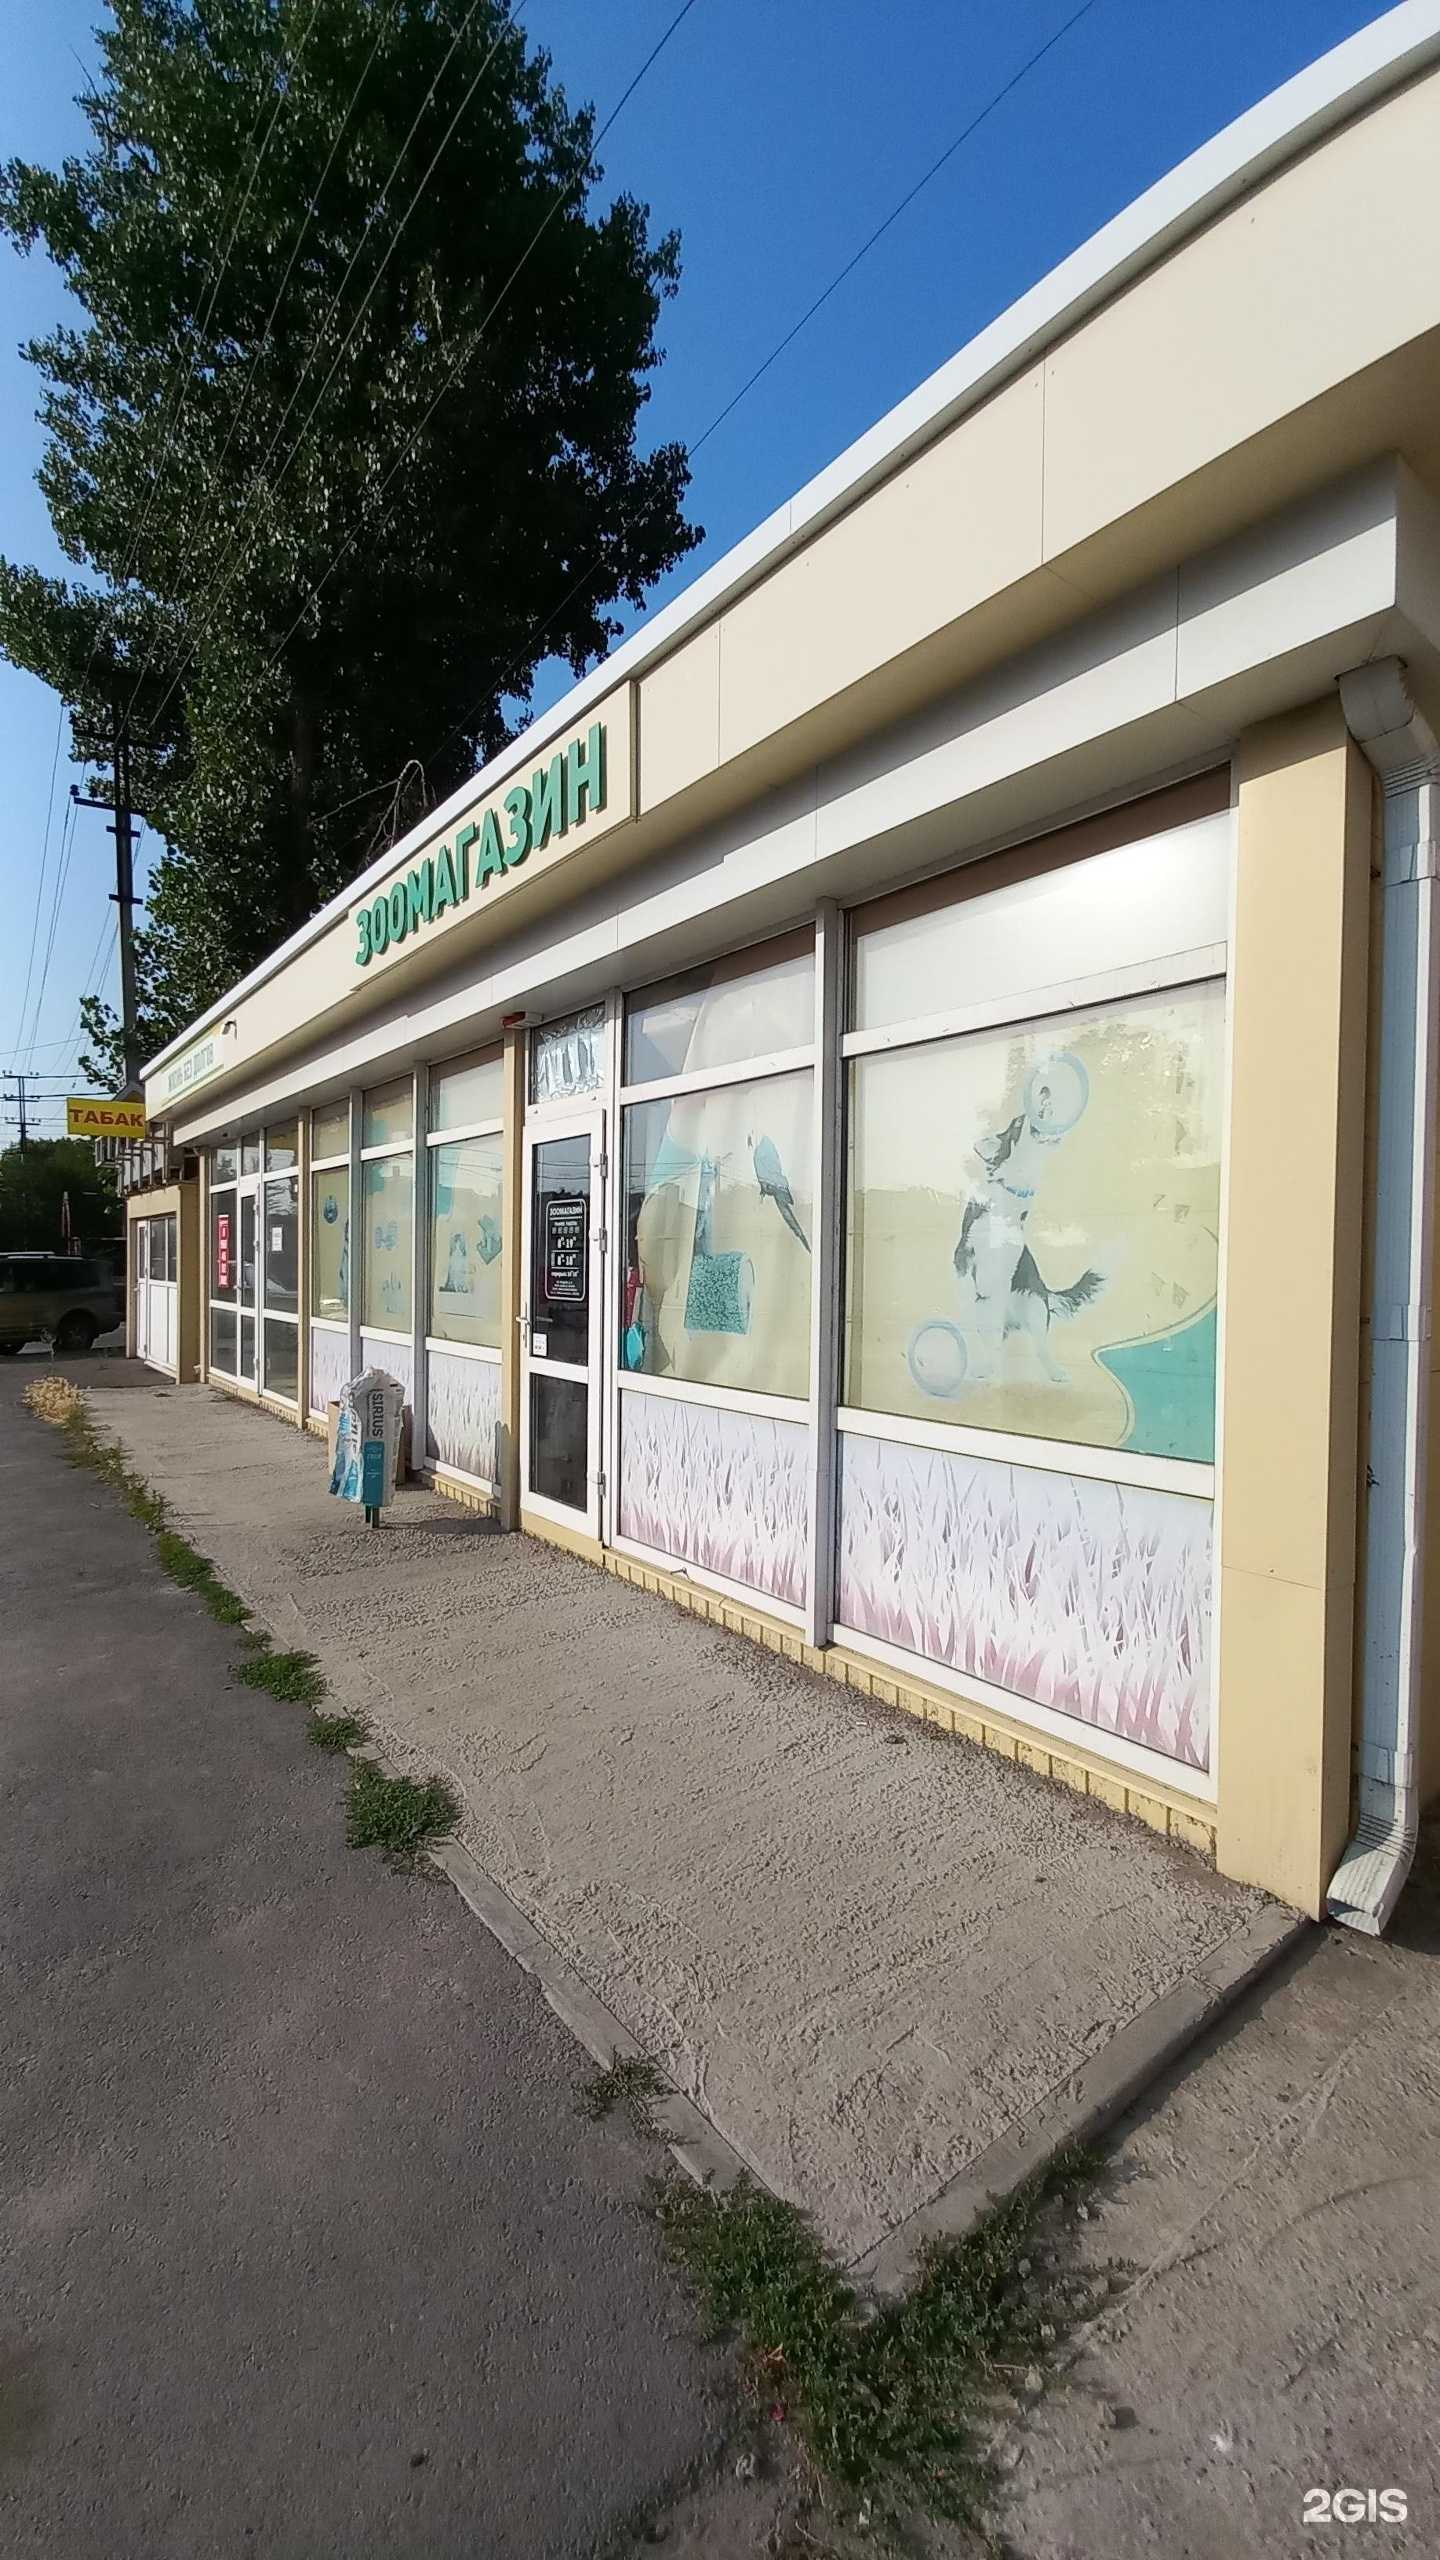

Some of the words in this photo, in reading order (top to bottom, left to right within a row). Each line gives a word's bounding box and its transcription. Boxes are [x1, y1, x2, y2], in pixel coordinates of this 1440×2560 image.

[354, 721, 604, 967] ЗООМАГАЗИН
[69, 1108, 144, 1128] ТАБАК
[371, 1393, 384, 1438] SIRIUS
